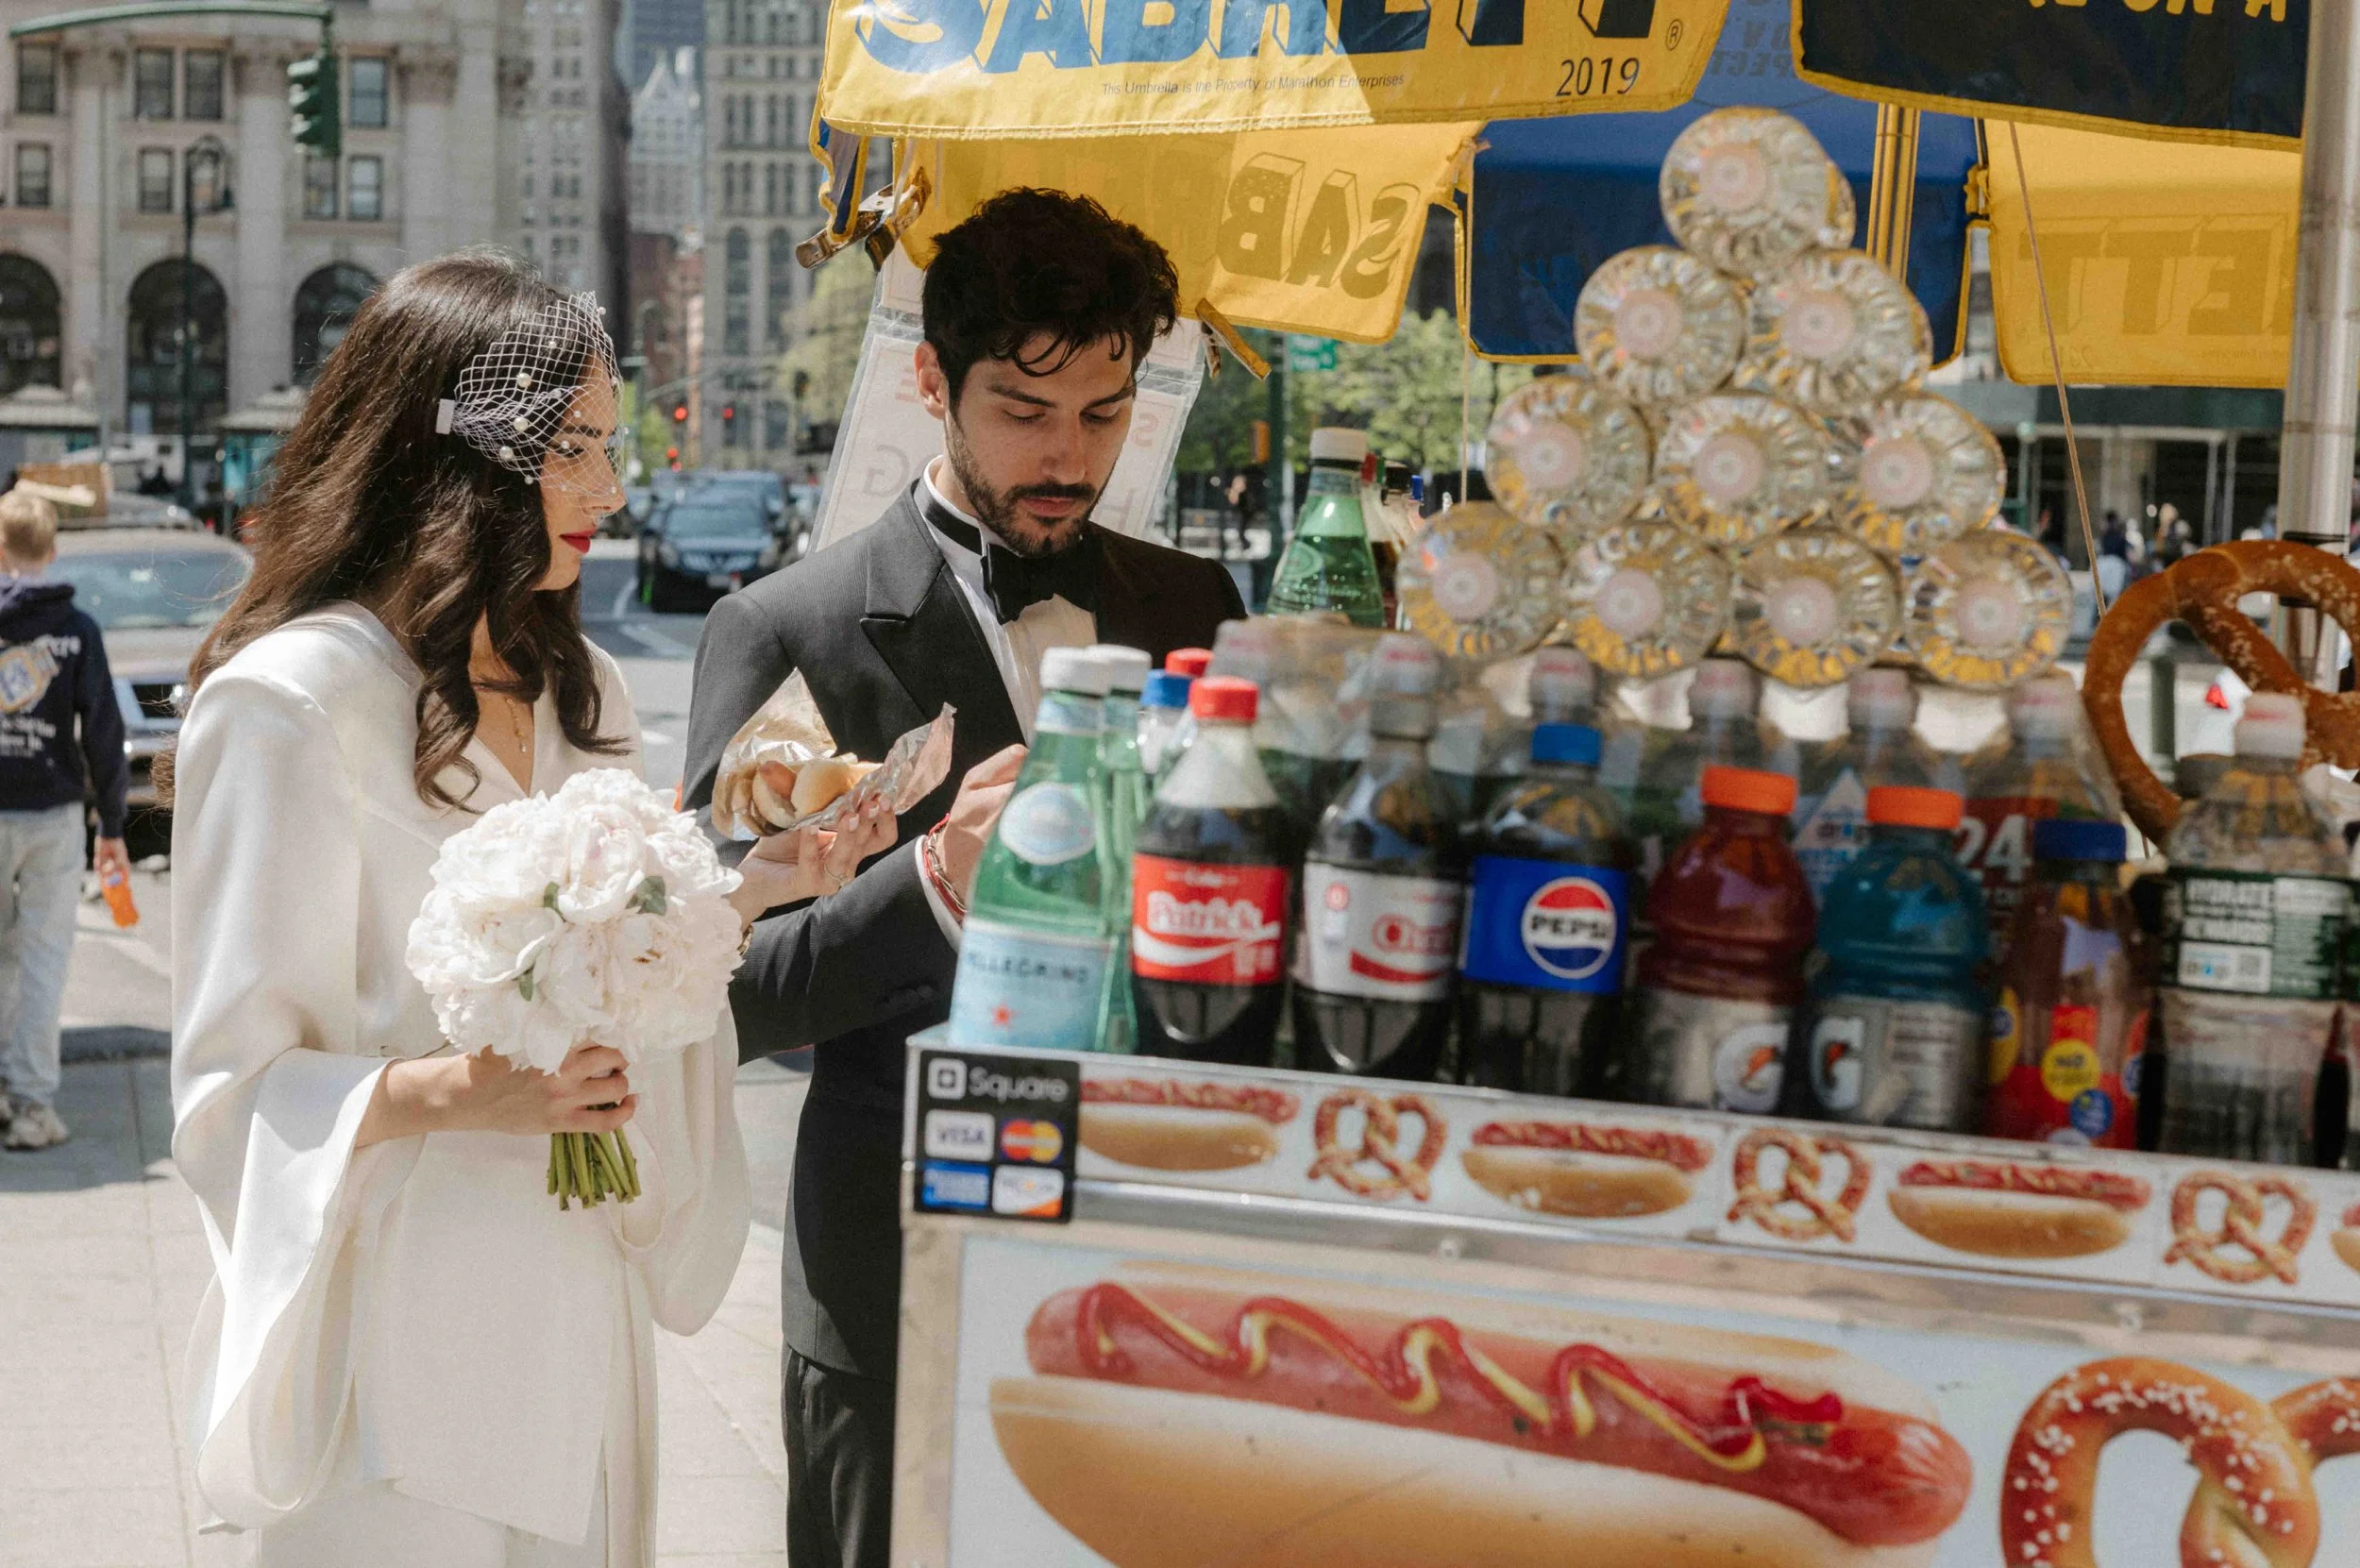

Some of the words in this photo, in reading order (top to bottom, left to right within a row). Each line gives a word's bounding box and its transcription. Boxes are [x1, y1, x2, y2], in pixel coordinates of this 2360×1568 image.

[1102, 82, 1121, 95] This
[1124, 79, 1178, 94] Umbrella
[1182, 80, 1192, 93] is
[1195, 79, 1212, 93] the
[1215, 77, 1258, 93] Property
[1264, 76, 1276, 91] of
[1278, 76, 1334, 91] Marathon
[1339, 73, 1405, 89] Enterprises
[1556, 57, 1641, 96] 2019
[969, 1066, 1070, 1104] Square
